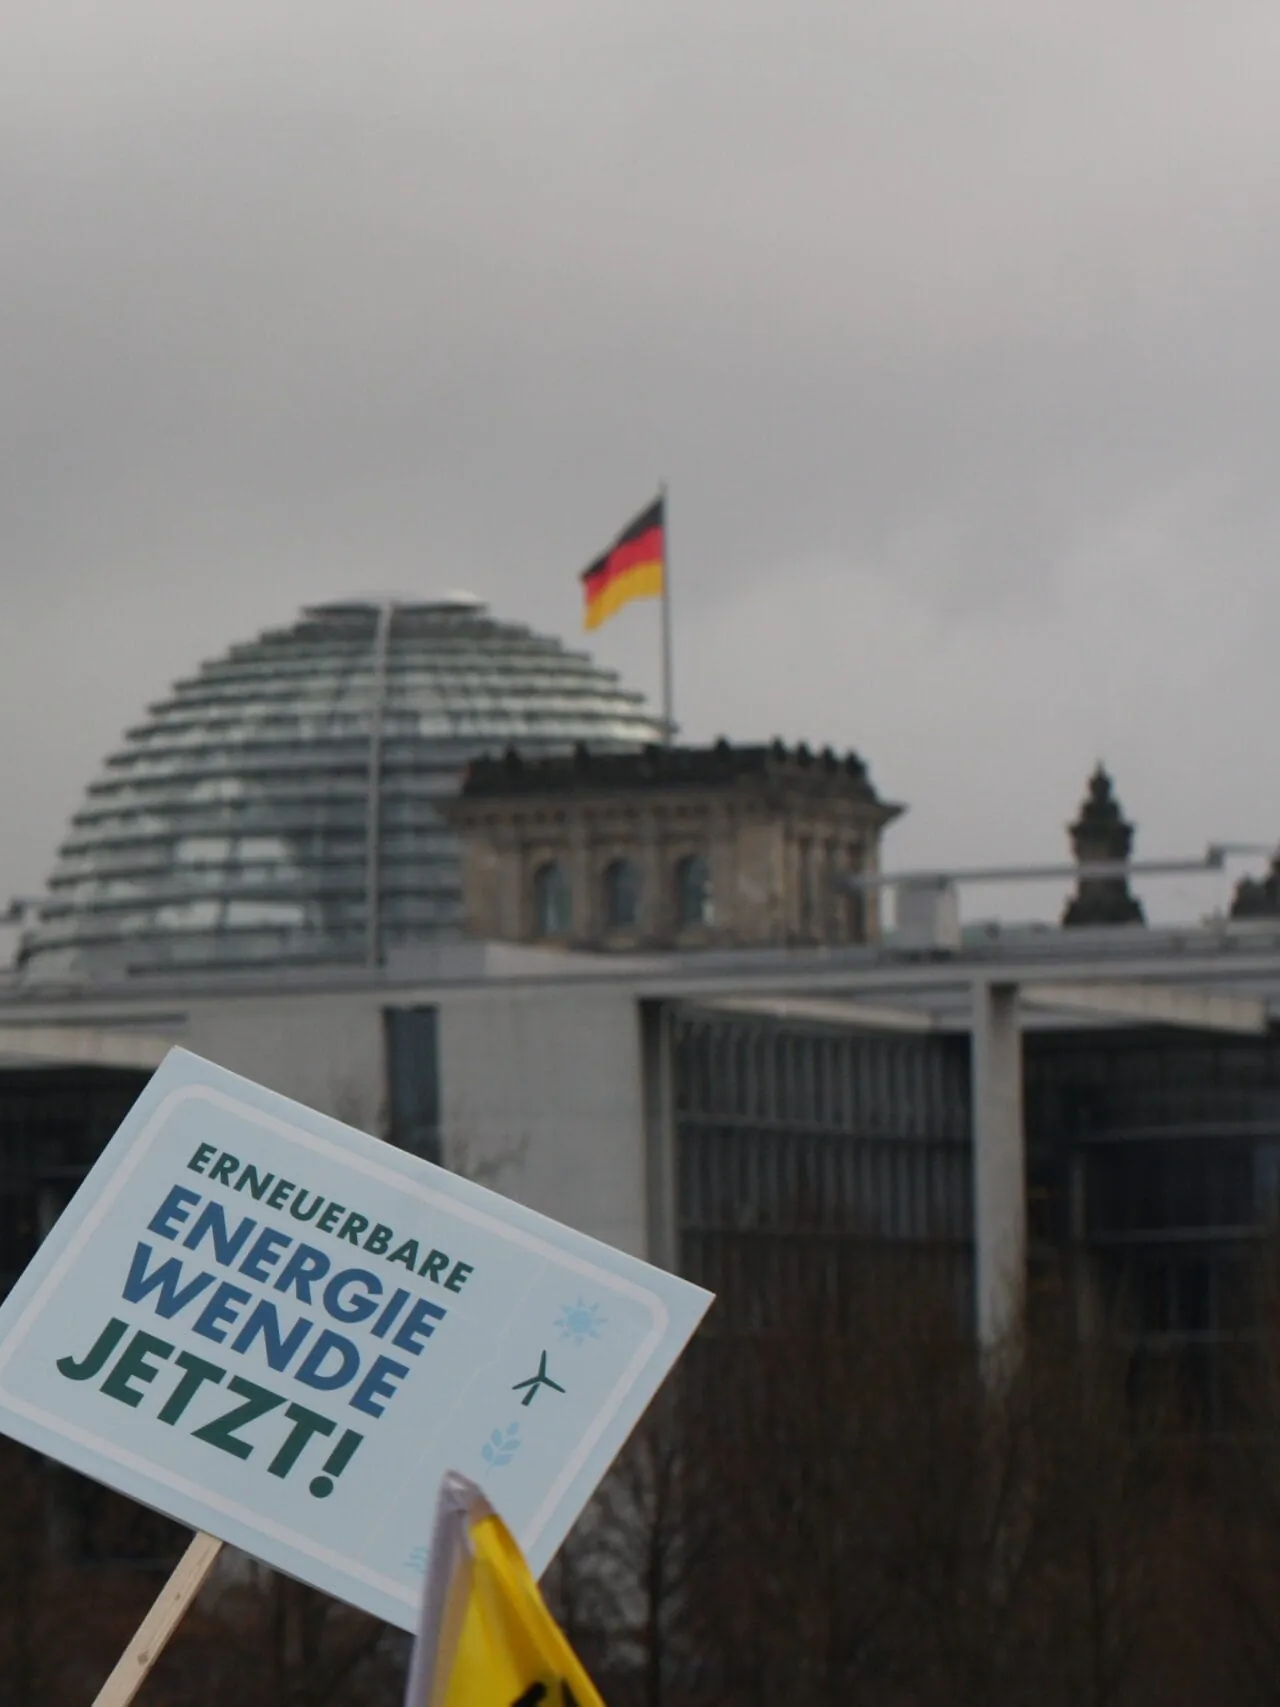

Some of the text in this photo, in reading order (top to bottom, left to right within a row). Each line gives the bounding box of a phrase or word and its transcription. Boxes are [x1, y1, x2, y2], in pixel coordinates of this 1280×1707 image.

[146, 1185, 447, 1357] ENERGIE
[186, 1142, 475, 1294] ERNEUERBARE
[55, 1316, 364, 1499] JETZT!
[121, 1242, 411, 1419] WENDE
